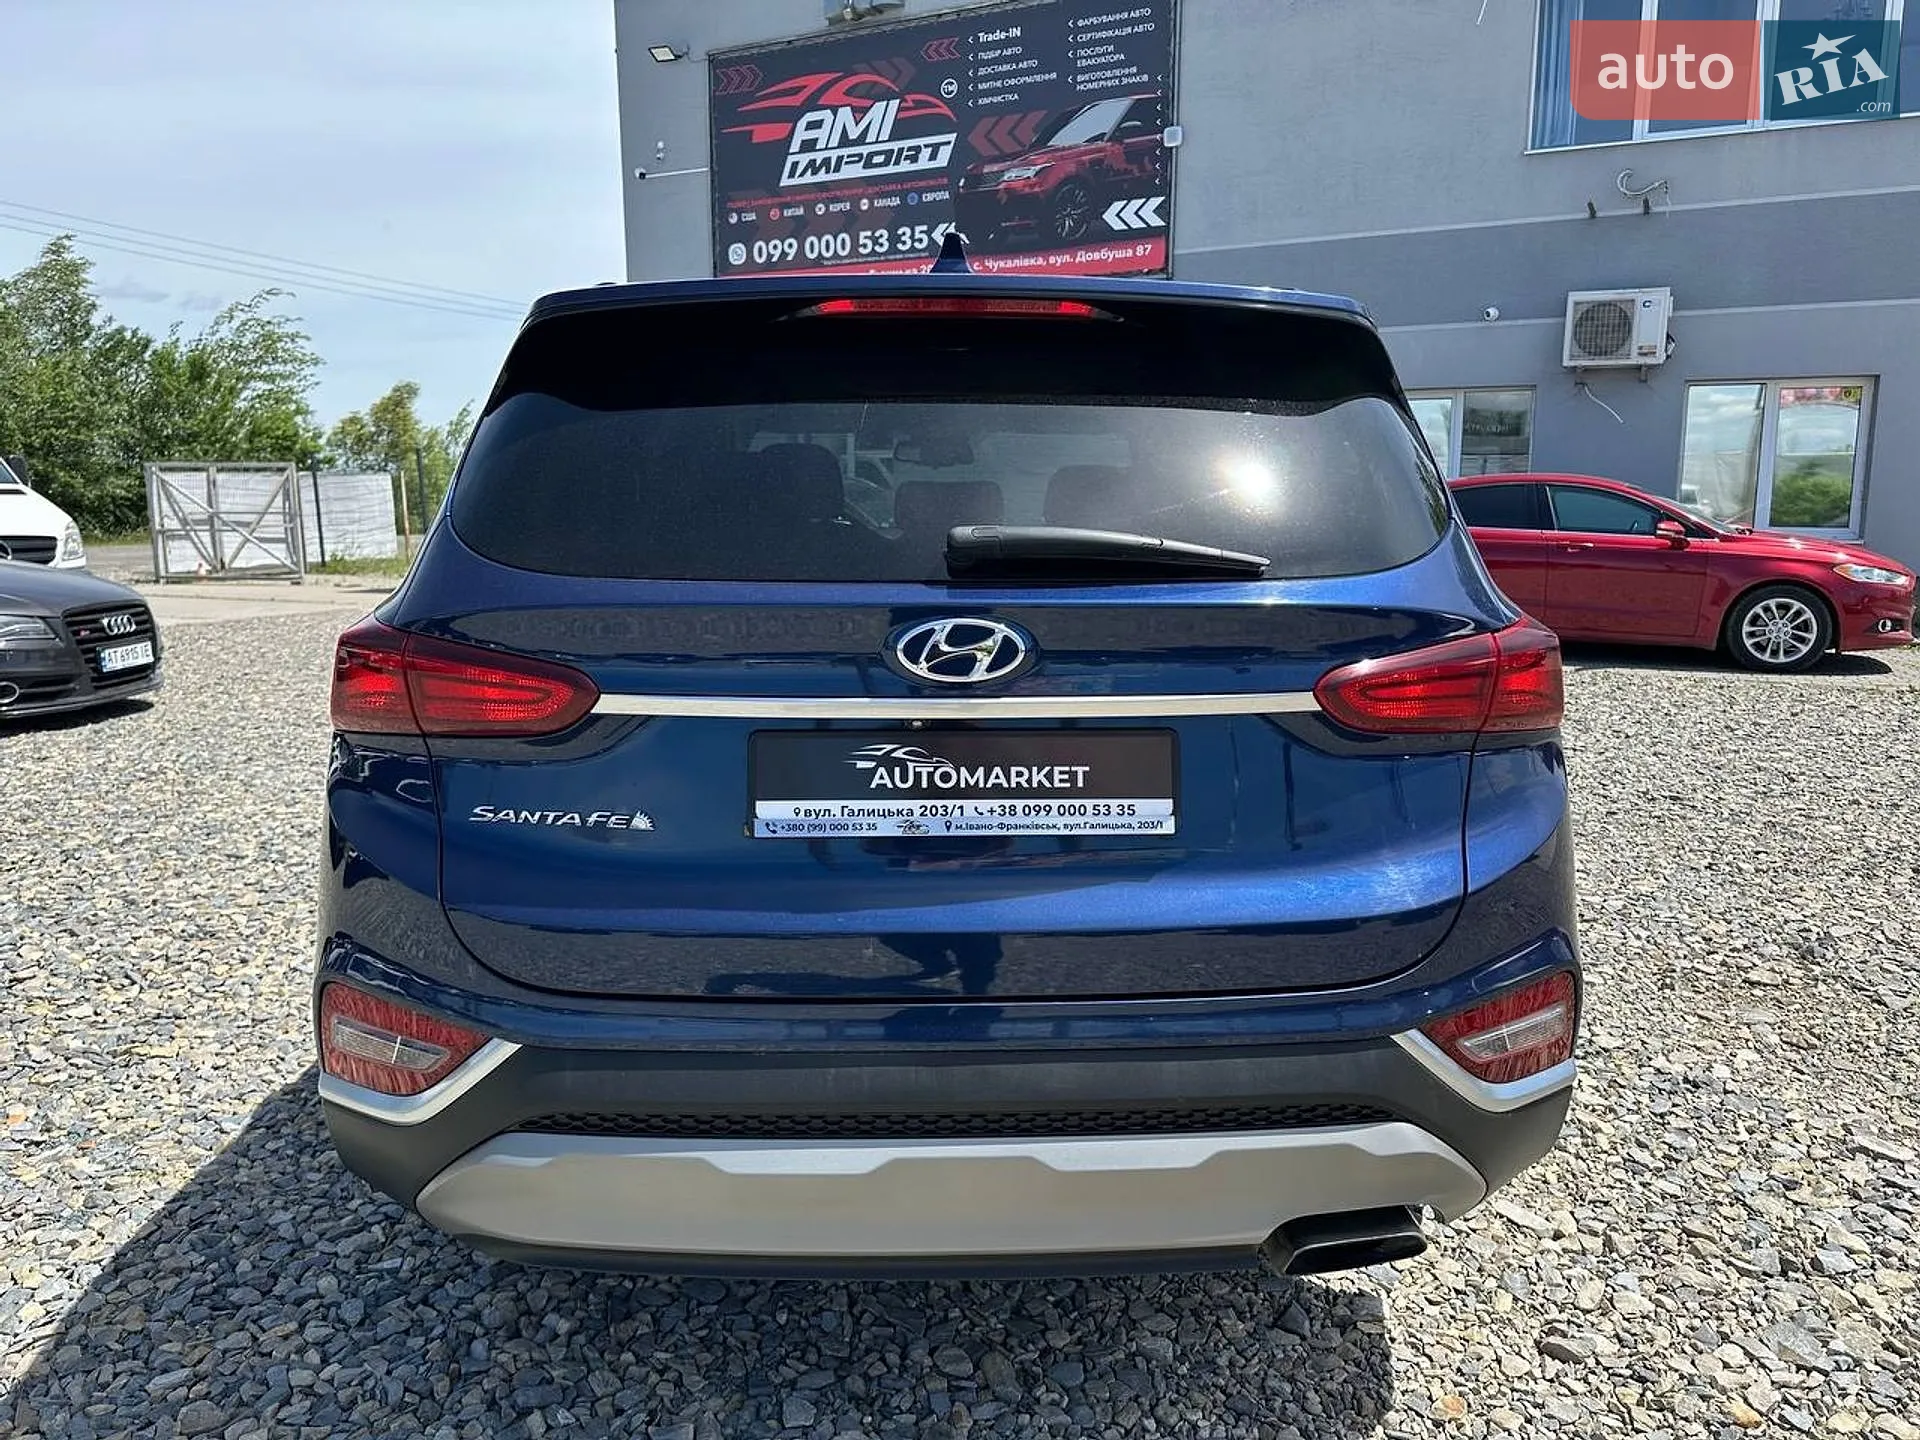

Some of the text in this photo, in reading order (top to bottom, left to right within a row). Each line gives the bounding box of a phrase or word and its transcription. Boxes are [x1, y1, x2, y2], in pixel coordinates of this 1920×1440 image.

[1130, 7, 1152, 18] АВТО
[978, 26, 1021, 43] Trade-IN
[1133, 23, 1155, 34] АВТО
[1002, 46, 1022, 56] АВТО
[1018, 59, 1038, 69] АВТО
[789, 99, 900, 153] AMI
[787, 141, 952, 179] IMPORT
[753, 238, 798, 264] 099
[804, 232, 852, 259] 000
[857, 228, 890, 254] 53
[896, 224, 929, 250] 35
[1135, 244, 1152, 256] 87
[870, 765, 1090, 789] AUTOMARKET
[469, 805, 630, 829] SANTA FE
[804, 804, 1136, 820] вул. Галицька 203/1 +38 099 000 53 35
[780, 822, 878, 833] +380 (99) 000 53 35
[1137, 821, 1164, 830] 203/1
